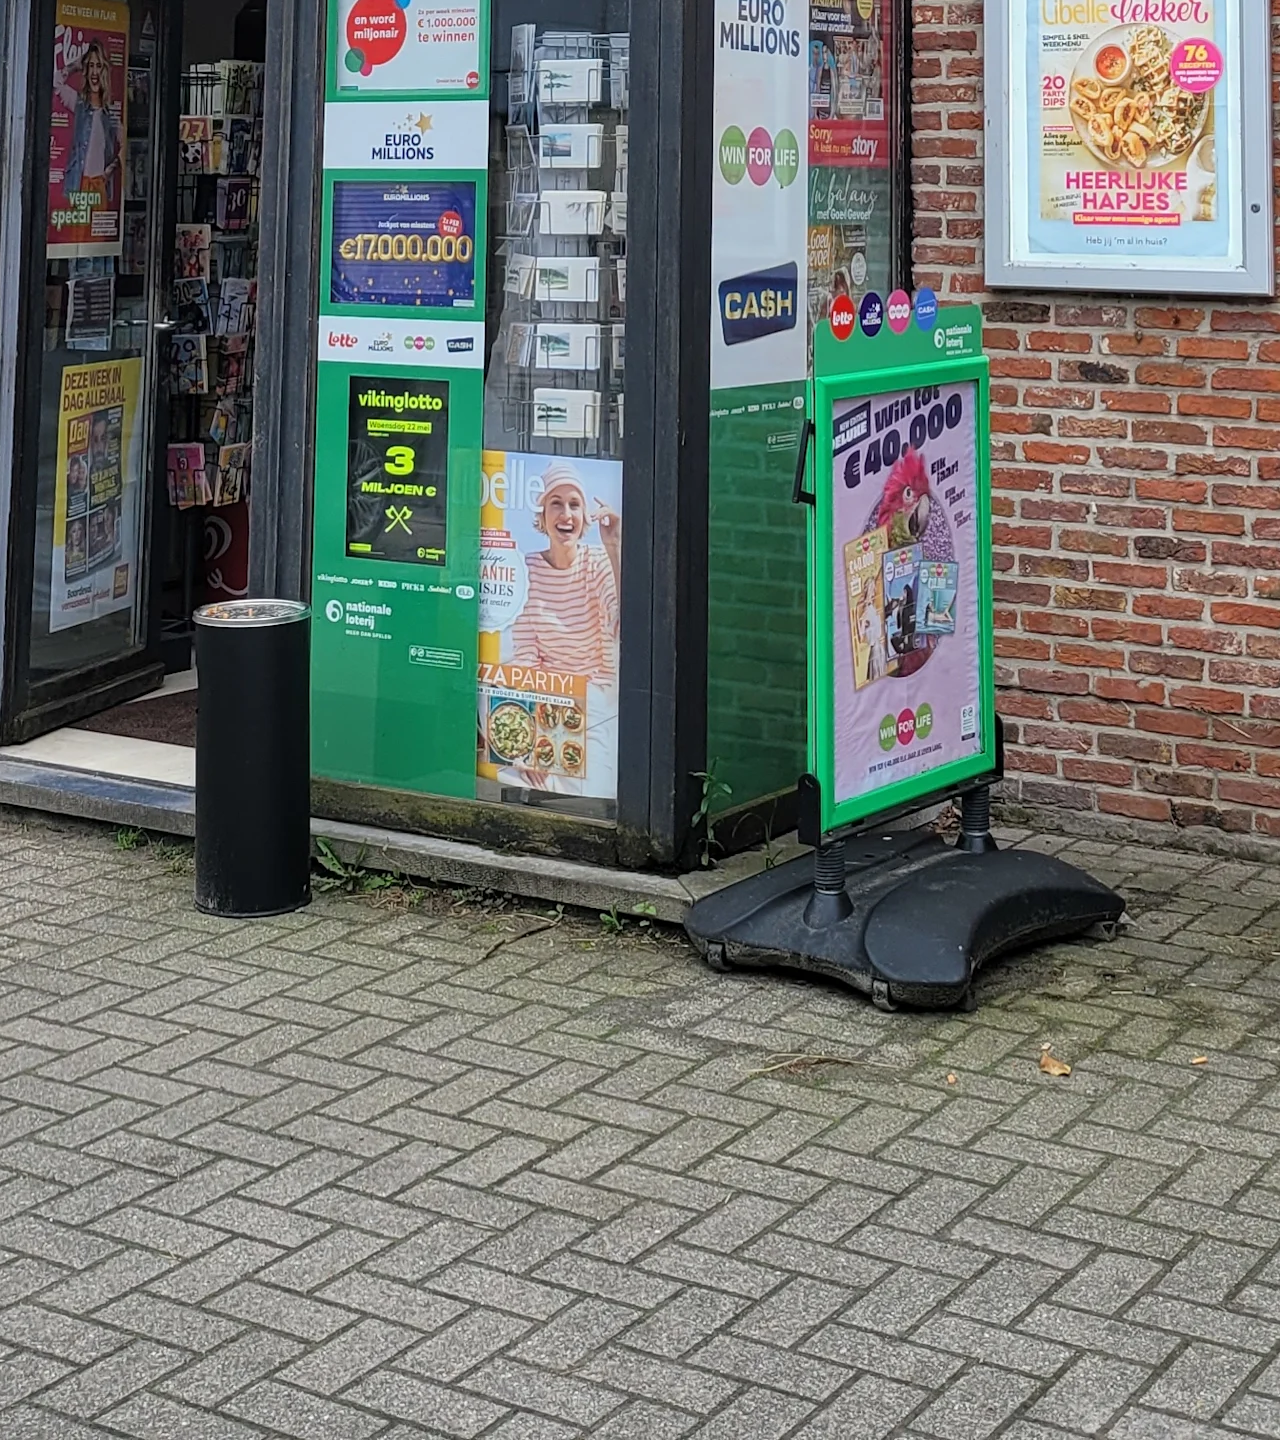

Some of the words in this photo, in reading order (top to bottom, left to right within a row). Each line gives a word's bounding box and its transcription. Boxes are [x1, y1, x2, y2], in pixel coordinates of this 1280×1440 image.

[354, 16, 366, 25] en
[369, 13, 396, 24] word
[353, 27, 399, 41] miljonair
[418, 32, 429, 43] te
[432, 31, 475, 42] winnen
[720, 21, 800, 57] MILLIONS
[1184, 45, 1208, 62] 76
[1042, 75, 1066, 90] 20
[1042, 98, 1066, 107] DIPS
[384, 134, 421, 147] EURO
[810, 124, 833, 143] Sorry,
[371, 147, 434, 161] MILLIONS
[722, 147, 745, 164] WIN
[749, 148, 770, 166] FOR
[775, 149, 796, 167] LIFE
[852, 135, 878, 162] story
[1065, 171, 1188, 191] HEERLIJKE
[70, 190, 101, 210] vegan
[1082, 192, 1170, 210] HAPJES
[52, 207, 91, 231] special
[1086, 236, 1102, 244] Heb
[1103, 237, 1112, 246] jij
[1145, 237, 1168, 245] huis?
[328, 331, 358, 348] lotto
[65, 368, 88, 390] DEZE
[89, 366, 111, 387] WEEK
[63, 393, 84, 411] DAG
[85, 387, 126, 407] ALLEMAAL
[358, 390, 443, 412] vikinglotto
[874, 396, 911, 433] Win
[369, 421, 406, 432] Woensdag
[407, 423, 416, 431] 22
[864, 392, 962, 477] 40.000
[384, 445, 415, 475] 3
[931, 457, 946, 476] Elk
[936, 460, 959, 486] jaar!
[362, 481, 423, 496] MILJOEN
[480, 460, 545, 512] belle
[479, 565, 516, 582] ANTIE
[346, 601, 392, 616] nationale
[346, 613, 375, 630] loterij
[477, 663, 507, 686] ZZA
[512, 668, 573, 694] PARTY!
[880, 723, 896, 740] WIN
[898, 720, 914, 734] FOR
[917, 715, 931, 729] LIFE
